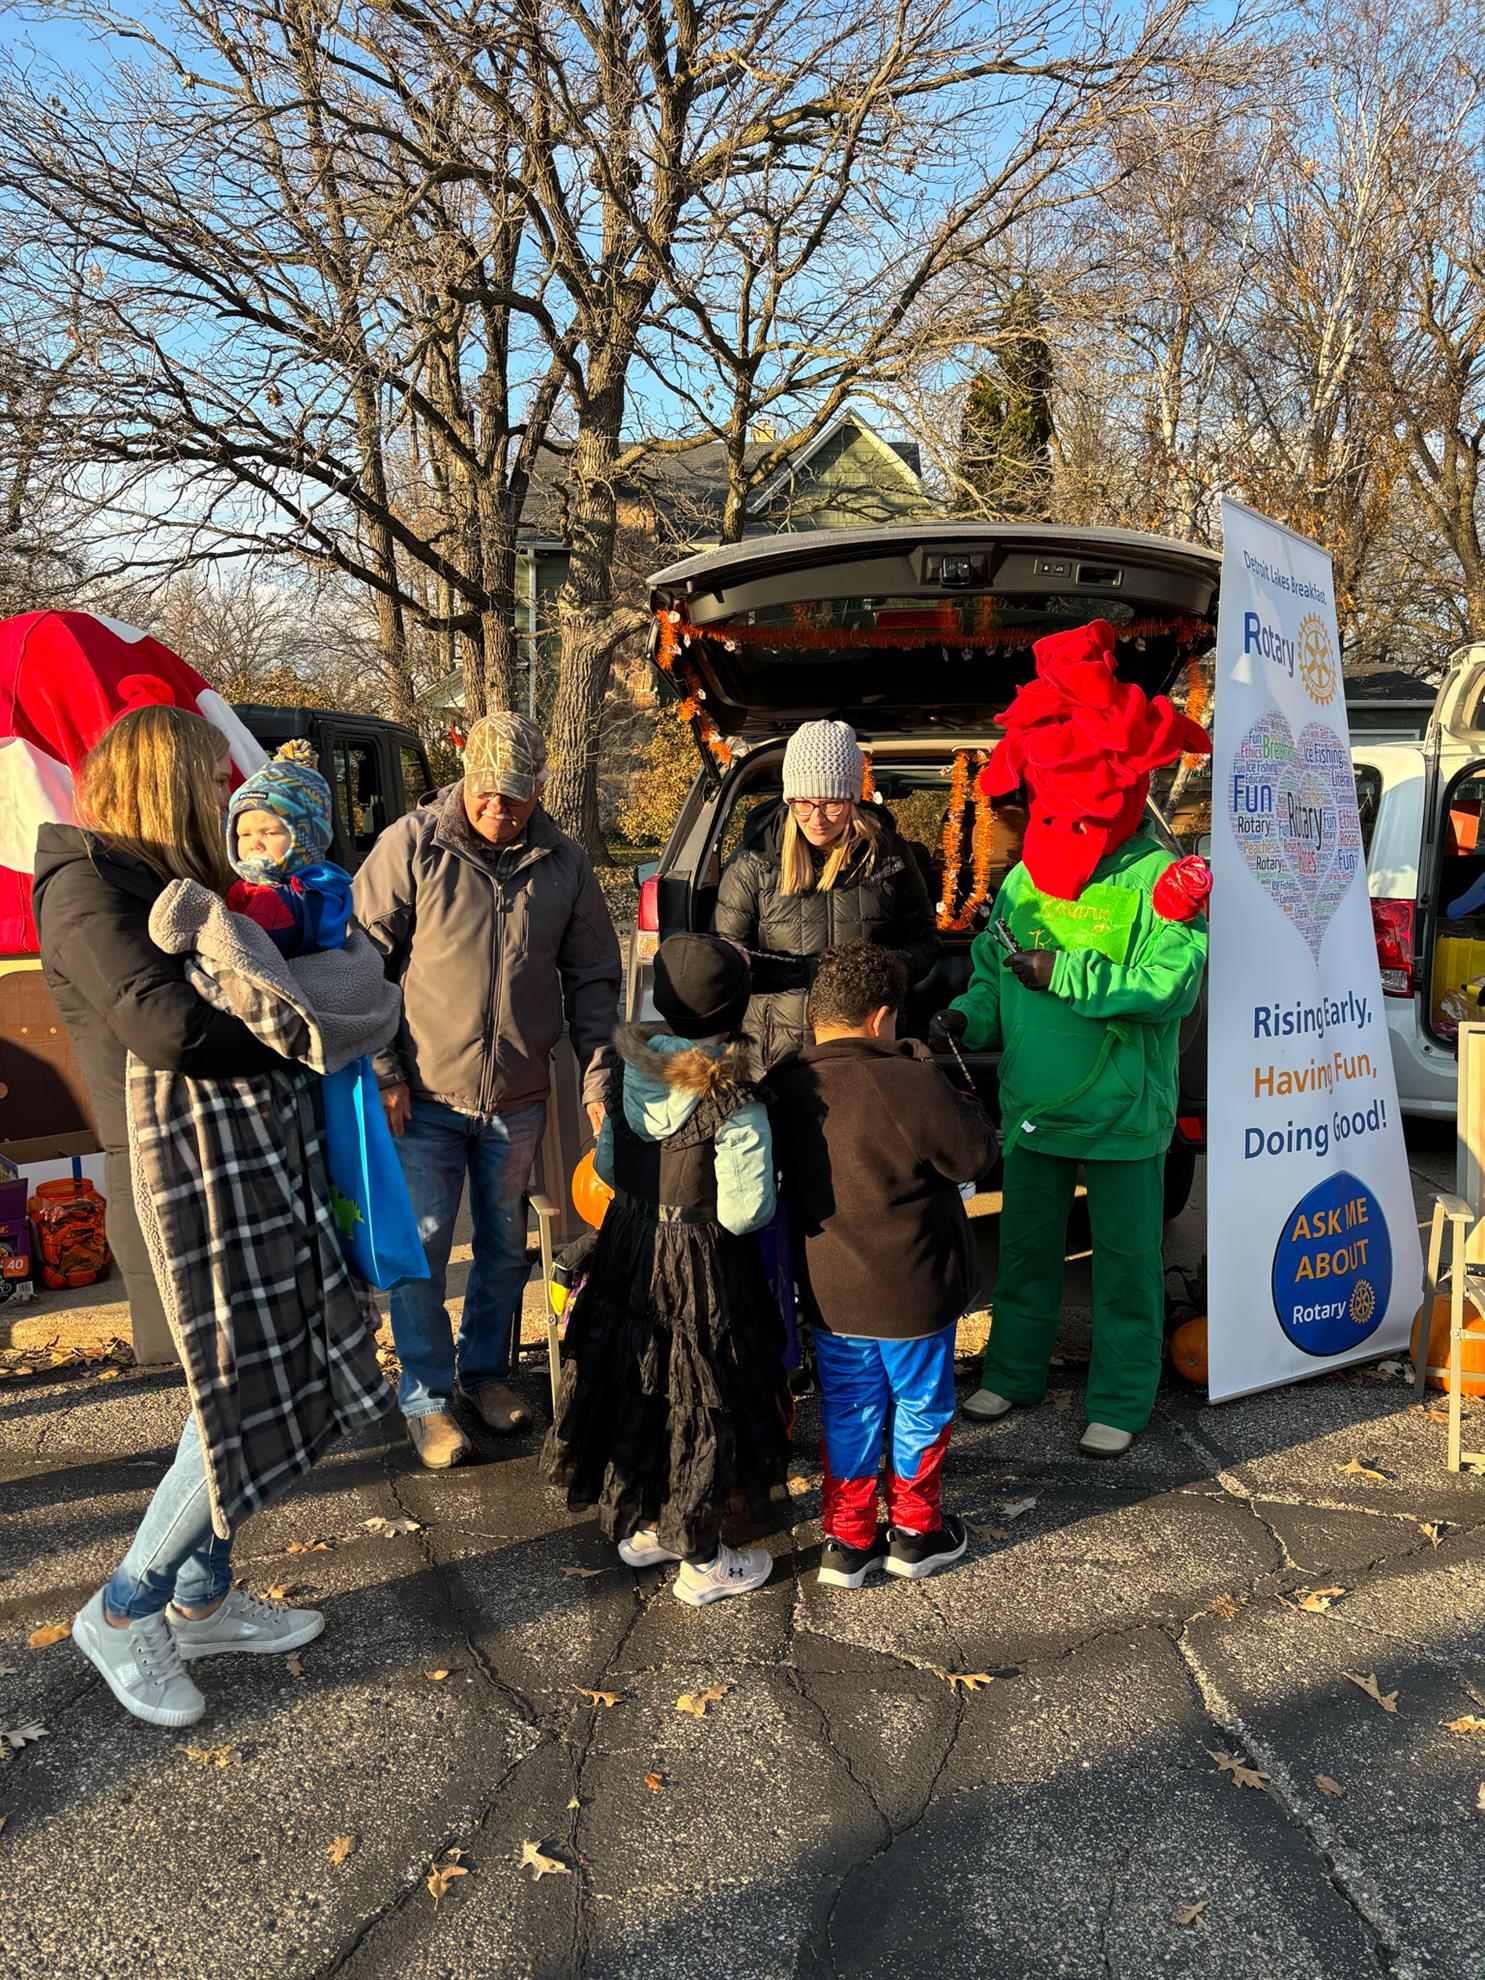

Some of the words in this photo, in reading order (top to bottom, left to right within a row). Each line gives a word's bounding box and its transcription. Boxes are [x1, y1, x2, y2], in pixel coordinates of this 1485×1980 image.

[1243, 550, 1269, 581] Detroit
[1269, 564, 1290, 591] Lakes
[1290, 575, 1327, 606] Breakfast
[1244, 612, 1294, 678] Rotary
[1249, 731, 1262, 745] Fun
[1241, 745, 1263, 759] Ethics
[1314, 743, 1344, 769] Fishing
[1233, 762, 1246, 774] Fun
[1246, 761, 1257, 773] Ice
[1234, 774, 1272, 813] Fun
[1238, 815, 1271, 838] Rotary
[1287, 791, 1322, 851] Rotary
[1323, 811, 1337, 829] Fun
[1338, 809, 1359, 829] Ethics
[1243, 839, 1276, 855] Peaches
[1339, 830, 1358, 847] Roses
[1256, 855, 1282, 873] Rotary
[1338, 848, 1356, 870] Fun
[1253, 1001, 1324, 1039] Rising
[1323, 990, 1373, 1030] Early,
[1254, 1058, 1333, 1099] Having
[1334, 1051, 1378, 1082] Fun,
[1244, 1121, 1329, 1160] Doing
[1333, 1100, 1388, 1142] Good!
[1291, 1207, 1341, 1242] ASK
[1344, 1197, 1369, 1230] ME
[8, 1258, 24, 1270] 40
[1294, 1239, 1369, 1283] ABOUT
[1292, 1299, 1347, 1325] Rotary
